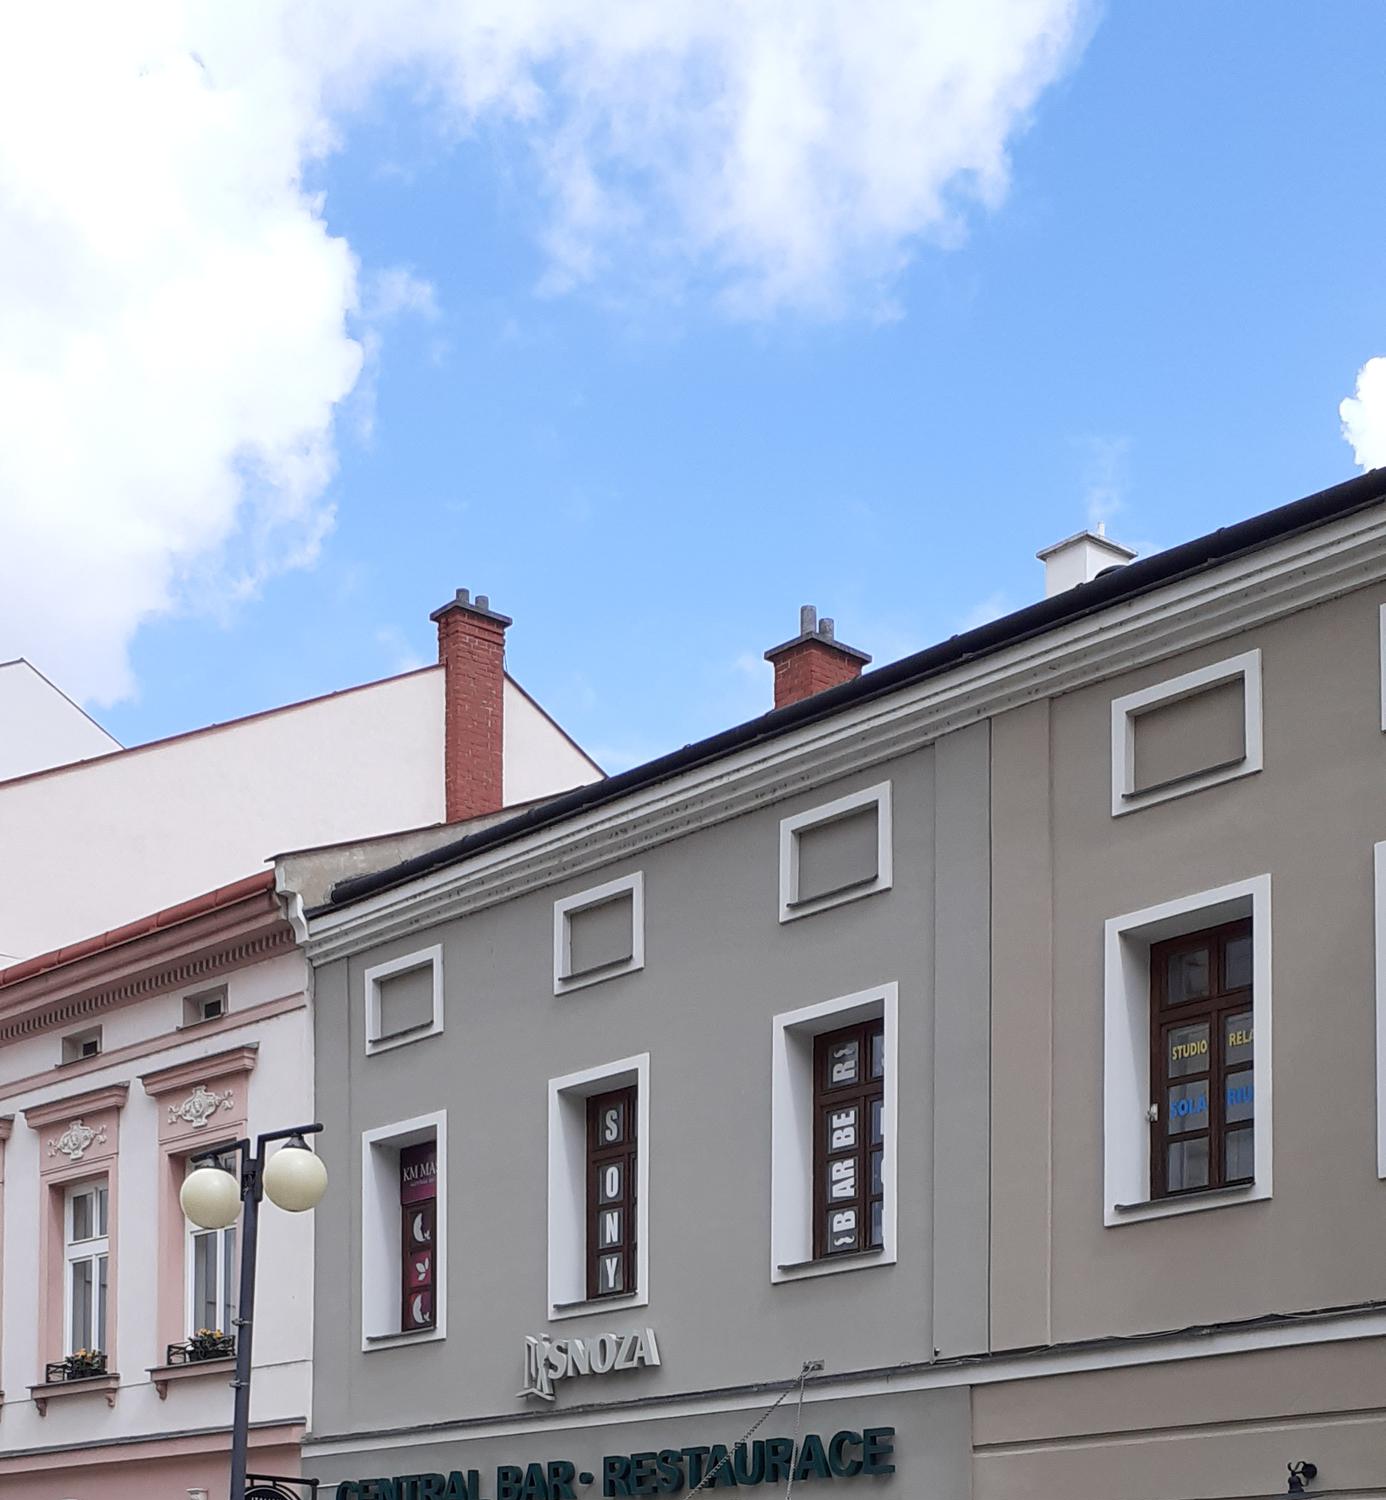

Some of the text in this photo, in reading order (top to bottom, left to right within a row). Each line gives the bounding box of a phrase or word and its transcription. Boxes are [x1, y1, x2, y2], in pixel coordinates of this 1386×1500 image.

[1172, 1039, 1208, 1060] STUDIO
[403, 1165, 418, 1181] KM
[605, 1109, 619, 1289] SONY
[548, 1327, 662, 1380] SNOZA
[603, 1426, 896, 1498] RESTAURACE
